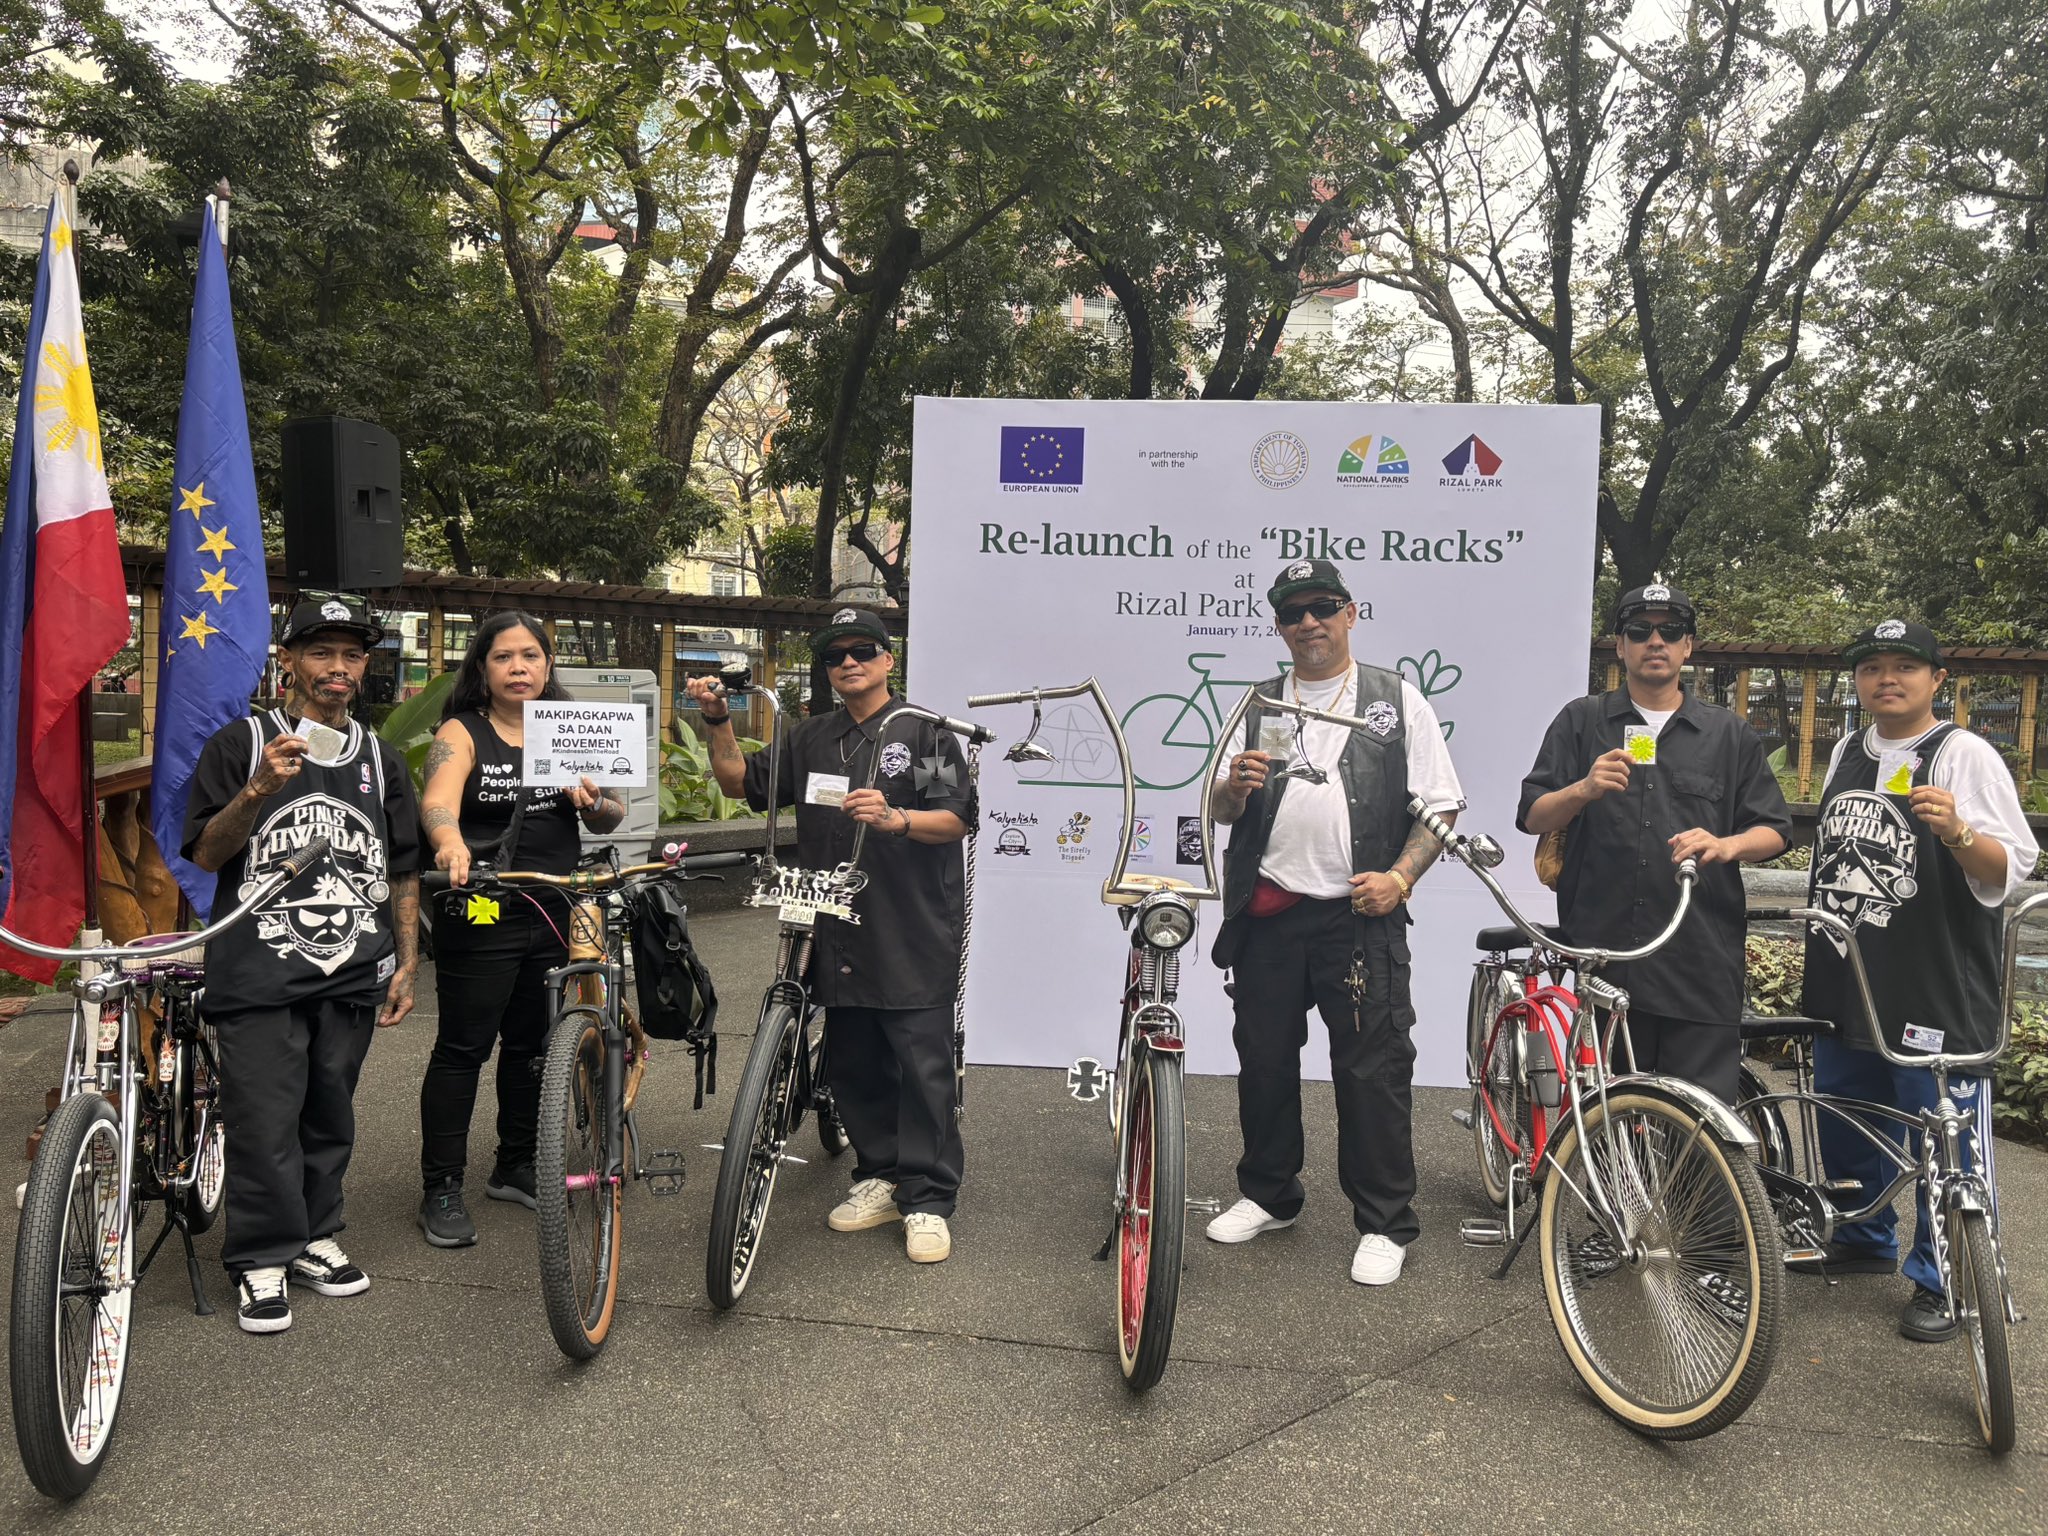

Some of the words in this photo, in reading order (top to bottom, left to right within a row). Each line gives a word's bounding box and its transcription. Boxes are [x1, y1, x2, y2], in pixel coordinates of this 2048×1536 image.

[1138, 449, 1147, 458] in
[1148, 449, 1199, 460] partnership
[1253, 433, 1282, 468] DEPARTMENT
[1293, 439, 1307, 469] TOURISM
[1151, 459, 1169, 468] with
[1171, 460, 1185, 468] the
[1258, 474, 1300, 488] PHILIPPINES
[1381, 476, 1409, 484] PARKS
[1439, 478, 1471, 487] RIZAL
[1474, 478, 1503, 487] PARK
[1003, 484, 1050, 493] EUROPEAN
[1052, 485, 1079, 493] UNION
[979, 522, 1174, 558] Re-launch
[1186, 539, 1210, 559] of
[1216, 539, 1251, 559] the
[1260, 527, 1366, 561] “Bike
[1379, 529, 1524, 563] Racks”
[1233, 572, 1255, 589] at
[1114, 591, 1188, 617] Rizal
[1197, 592, 1263, 618] Park
[1185, 624, 1239, 638] January
[1244, 625, 1262, 638] 17,
[534, 710, 635, 721] MAKIPAGKAPWA
[557, 724, 575, 734] SA
[578, 725, 612, 735] DAAN
[551, 738, 622, 749] MOVEMENT
[481, 763, 502, 775] We
[478, 791, 519, 802] Car-fr
[1833, 799, 1886, 821] PINAS
[1867, 914, 1885, 925] 2011
